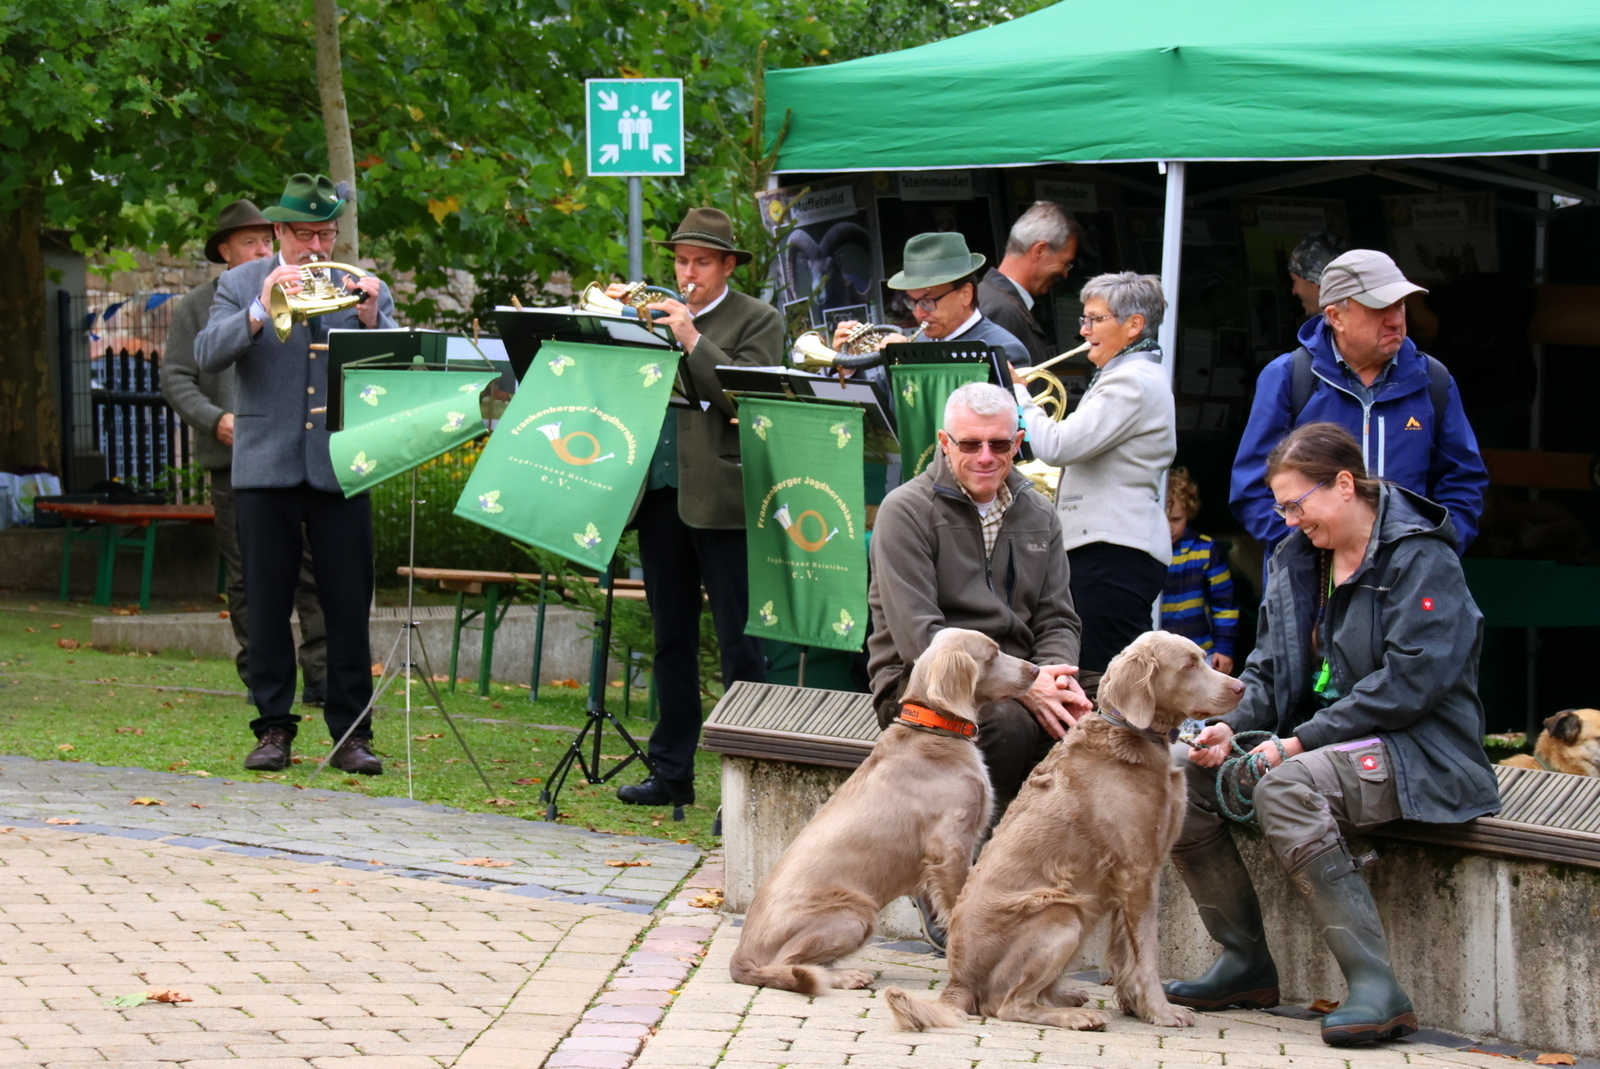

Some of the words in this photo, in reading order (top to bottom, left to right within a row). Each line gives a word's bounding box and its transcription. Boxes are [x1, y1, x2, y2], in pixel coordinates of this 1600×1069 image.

[902, 175, 969, 188] Steinmarder
[1043, 185, 1088, 199] Waschbär
[793, 190, 844, 213] Muffelwild
[1260, 209, 1323, 223] Eichhörnchen
[1415, 208, 1459, 220] Stockente
[511, 405, 588, 436] Frankenberger
[589, 406, 637, 466] Jagdhornbläser
[508, 455, 566, 476] Jagdverband
[567, 473, 613, 491] Hainichen
[757, 476, 802, 529] Frankenberger
[803, 476, 855, 540] Jagdhornbläser
